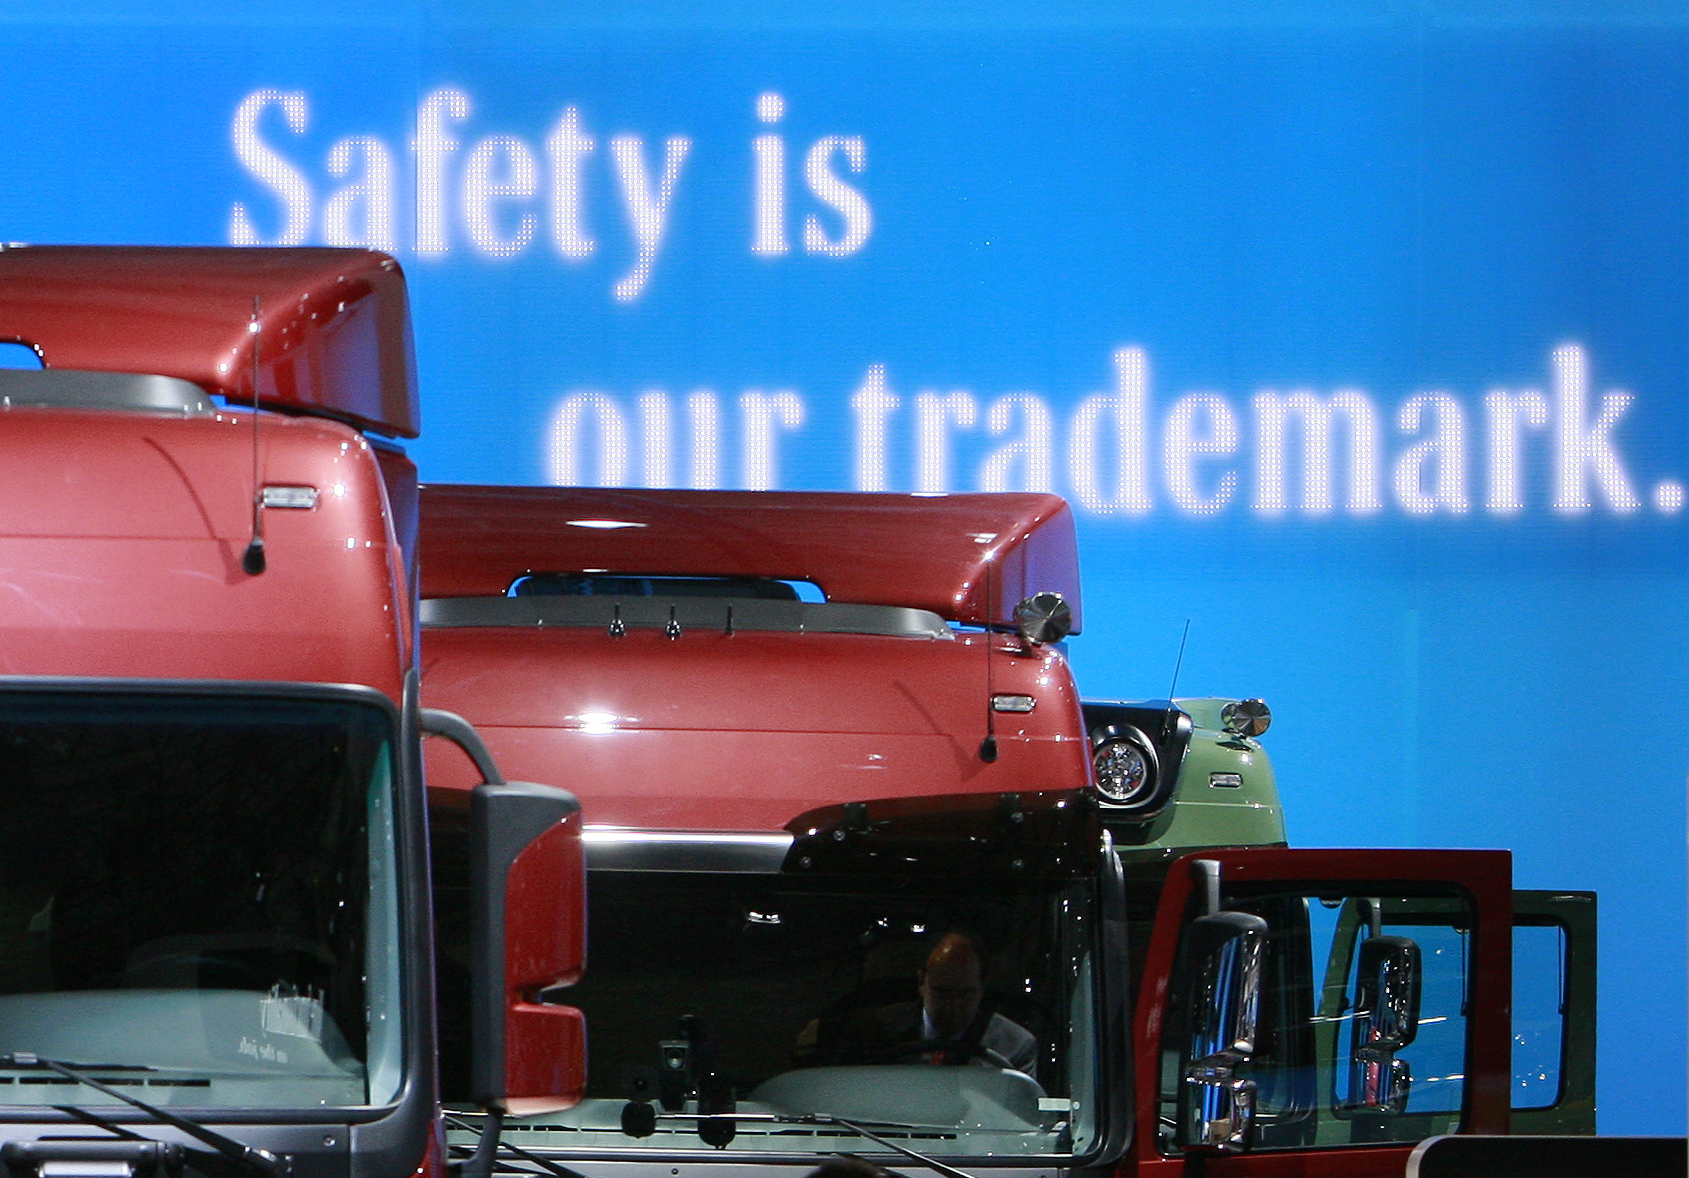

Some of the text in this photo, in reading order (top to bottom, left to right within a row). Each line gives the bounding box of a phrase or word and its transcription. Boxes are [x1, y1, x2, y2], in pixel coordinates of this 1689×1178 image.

[229, 88, 872, 302] Safety is
[547, 345, 1686, 514] our trademark.
